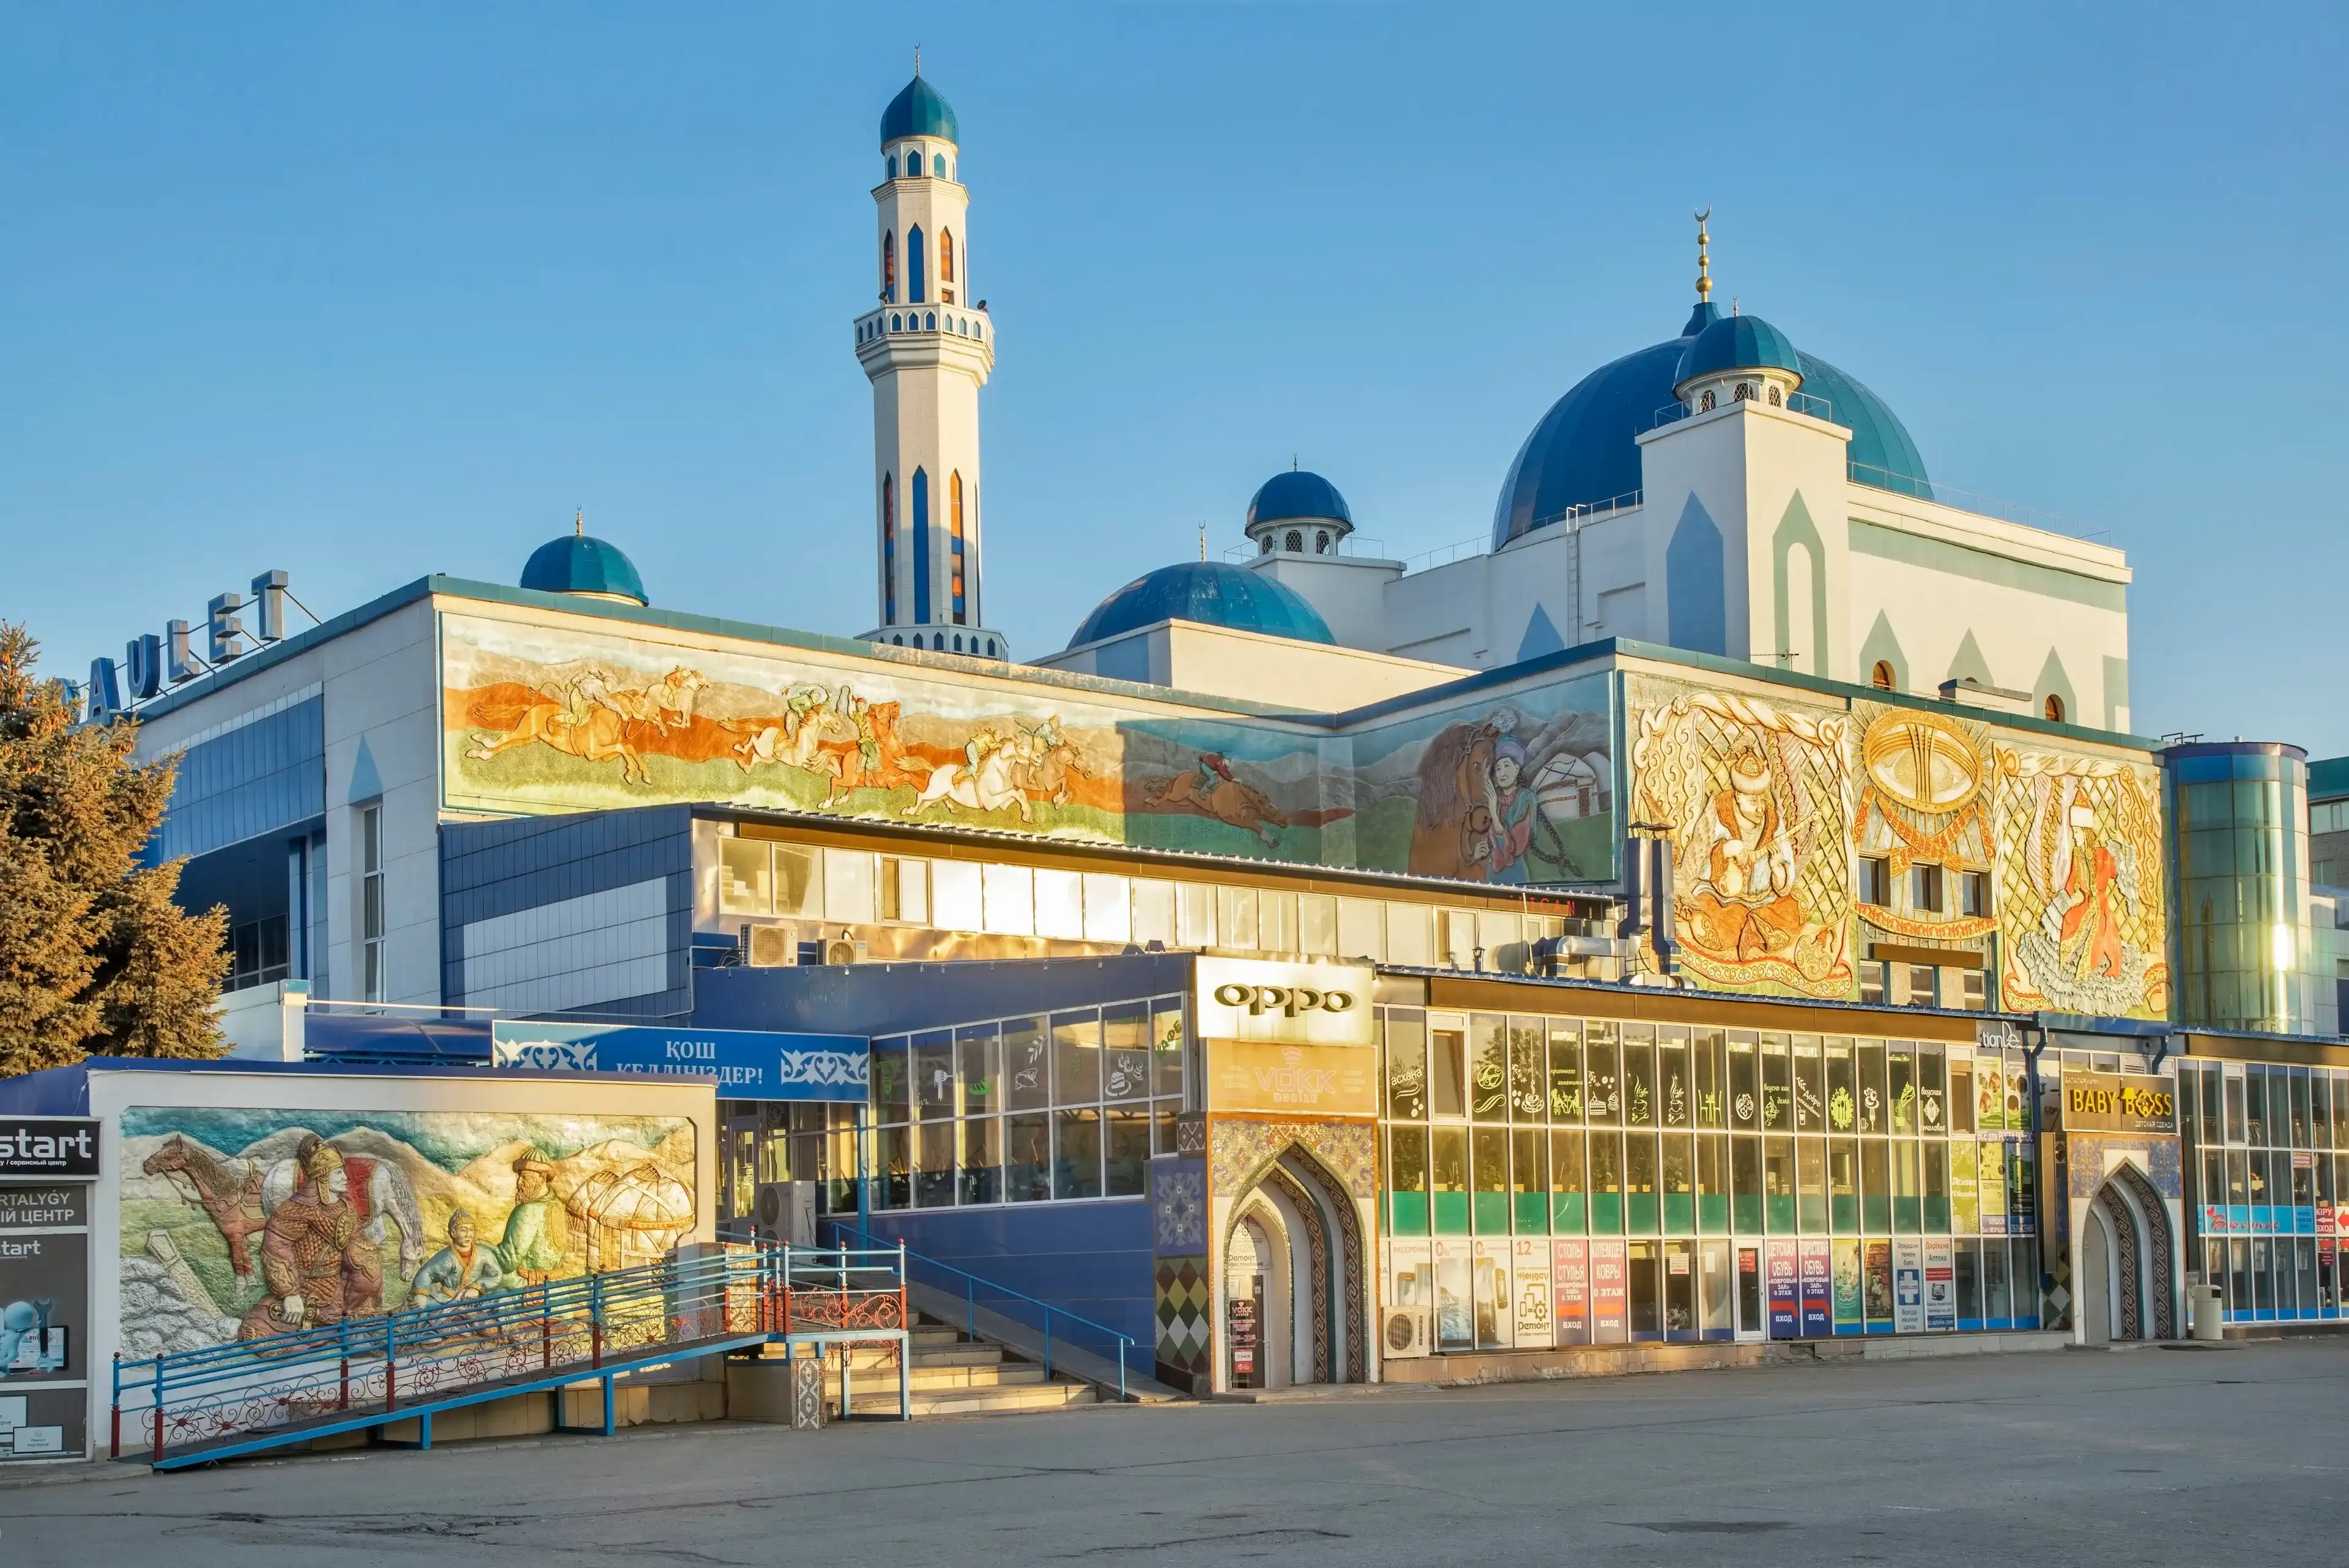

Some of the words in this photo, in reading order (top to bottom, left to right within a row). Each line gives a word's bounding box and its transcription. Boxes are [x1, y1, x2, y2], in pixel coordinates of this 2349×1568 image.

[1214, 984, 1357, 1017] oppo
[666, 1041, 716, 1061] ҚОШ
[1391, 1069, 1422, 1085] асхана
[1764, 1083, 1779, 1093] вкусно
[1921, 1087, 1942, 1097] вкусная
[1803, 1090, 1821, 1107] Добро
[2070, 1089, 2117, 1113] BABY
[1797, 1096, 1820, 1118] пожаловать
[1920, 1123, 1945, 1131] столовая
[1977, 1131, 1987, 1141] ВСЕ
[1998, 1131, 2015, 1142] РОСТА
[21, 1209, 75, 1224] ЦЕНТР
[0, 1240, 41, 1255] tart
[1516, 1241, 1532, 1255] 12
[1557, 1243, 1583, 1259] СТОЛЫ
[1768, 1241, 1796, 1259] ДЕТСКАЯ
[1557, 1265, 1584, 1280] СТУЛЬЯ
[1596, 1264, 1622, 1280] КОВРЫ
[1772, 1261, 1793, 1277] ОБУВЬ
[1804, 1260, 1824, 1276] ОБУВЬ
[1600, 1288, 1625, 1296] ЭТАЖ
